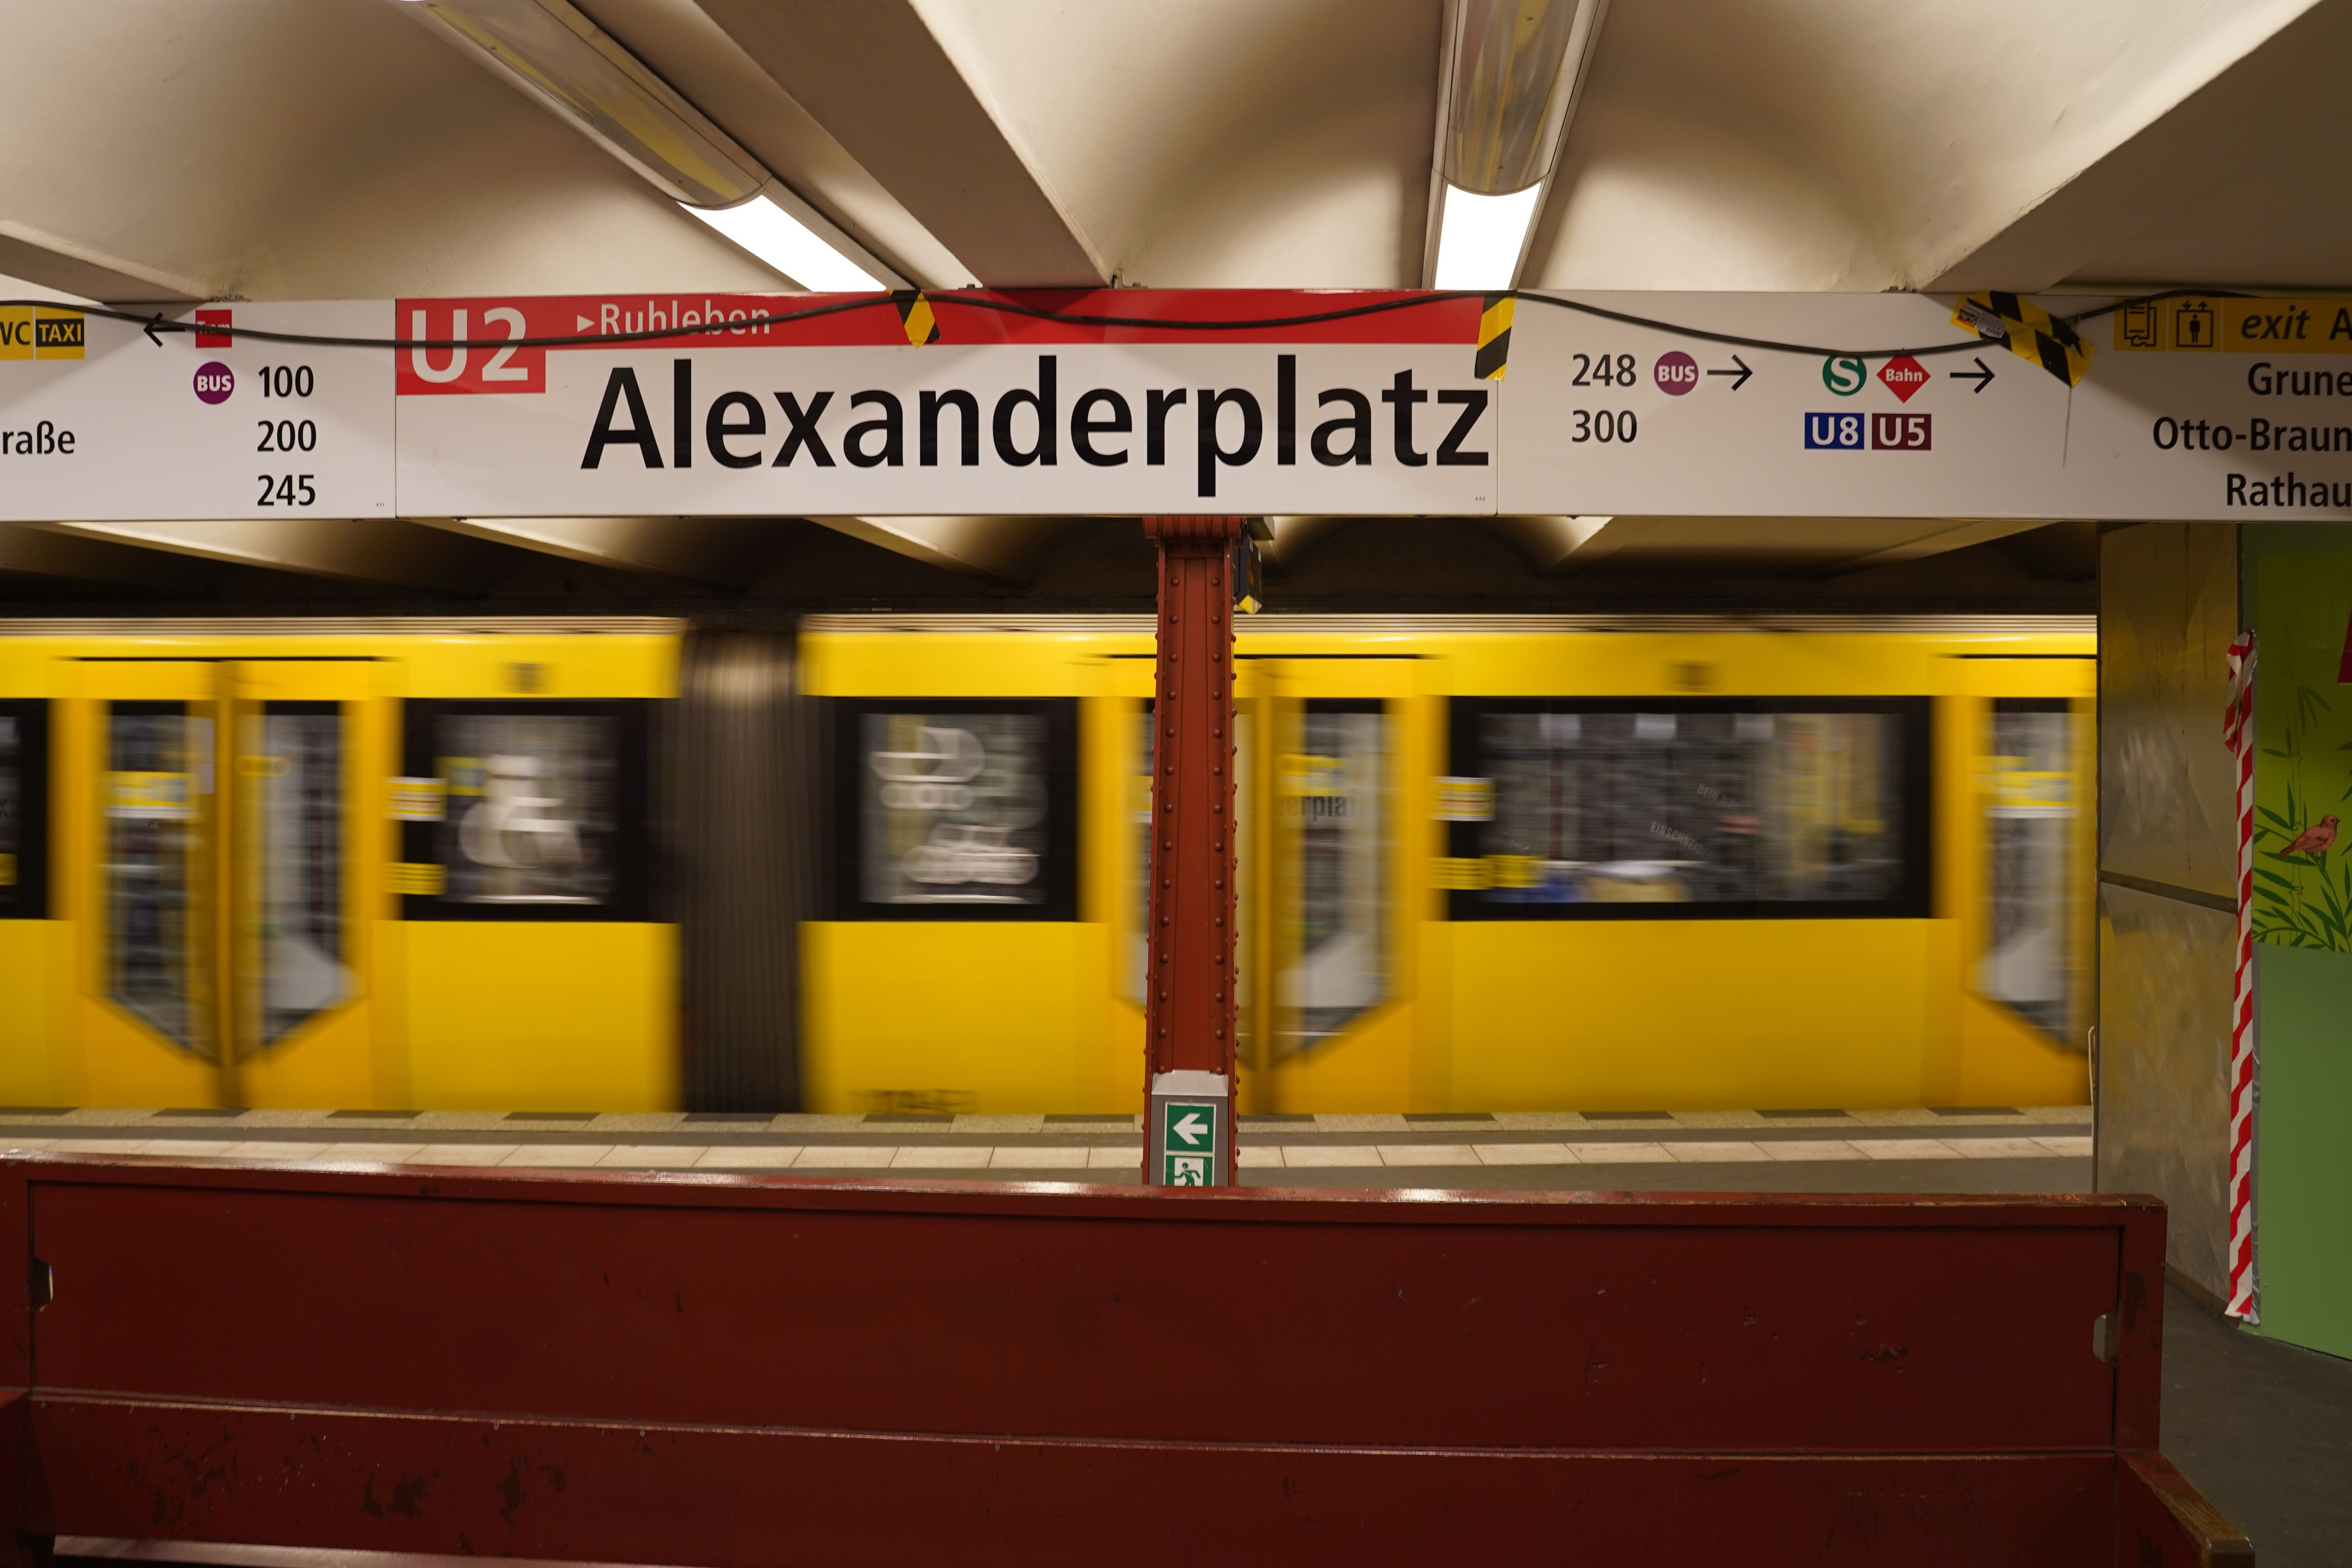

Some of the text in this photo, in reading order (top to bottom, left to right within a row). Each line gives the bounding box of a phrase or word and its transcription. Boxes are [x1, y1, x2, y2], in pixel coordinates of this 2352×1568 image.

[39, 323, 81, 342] TAXI
[601, 299, 769, 335] Ruhleben
[2241, 305, 2310, 339] exit
[412, 307, 528, 383] U2
[197, 366, 314, 398] BUS 100
[1572, 354, 1695, 387] 248 BUS
[1831, 356, 1922, 392] S Bahn
[2248, 363, 2352, 396] Grune
[3, 421, 75, 454] raße
[257, 420, 316, 452] 200
[581, 354, 1489, 497] Alexanderplatz
[1572, 410, 1637, 443] 300
[1813, 416, 1925, 446] U8 U5
[2153, 417, 2352, 451] Otto-Braun
[257, 475, 315, 506] 245
[2227, 473, 2352, 507] Rathau
